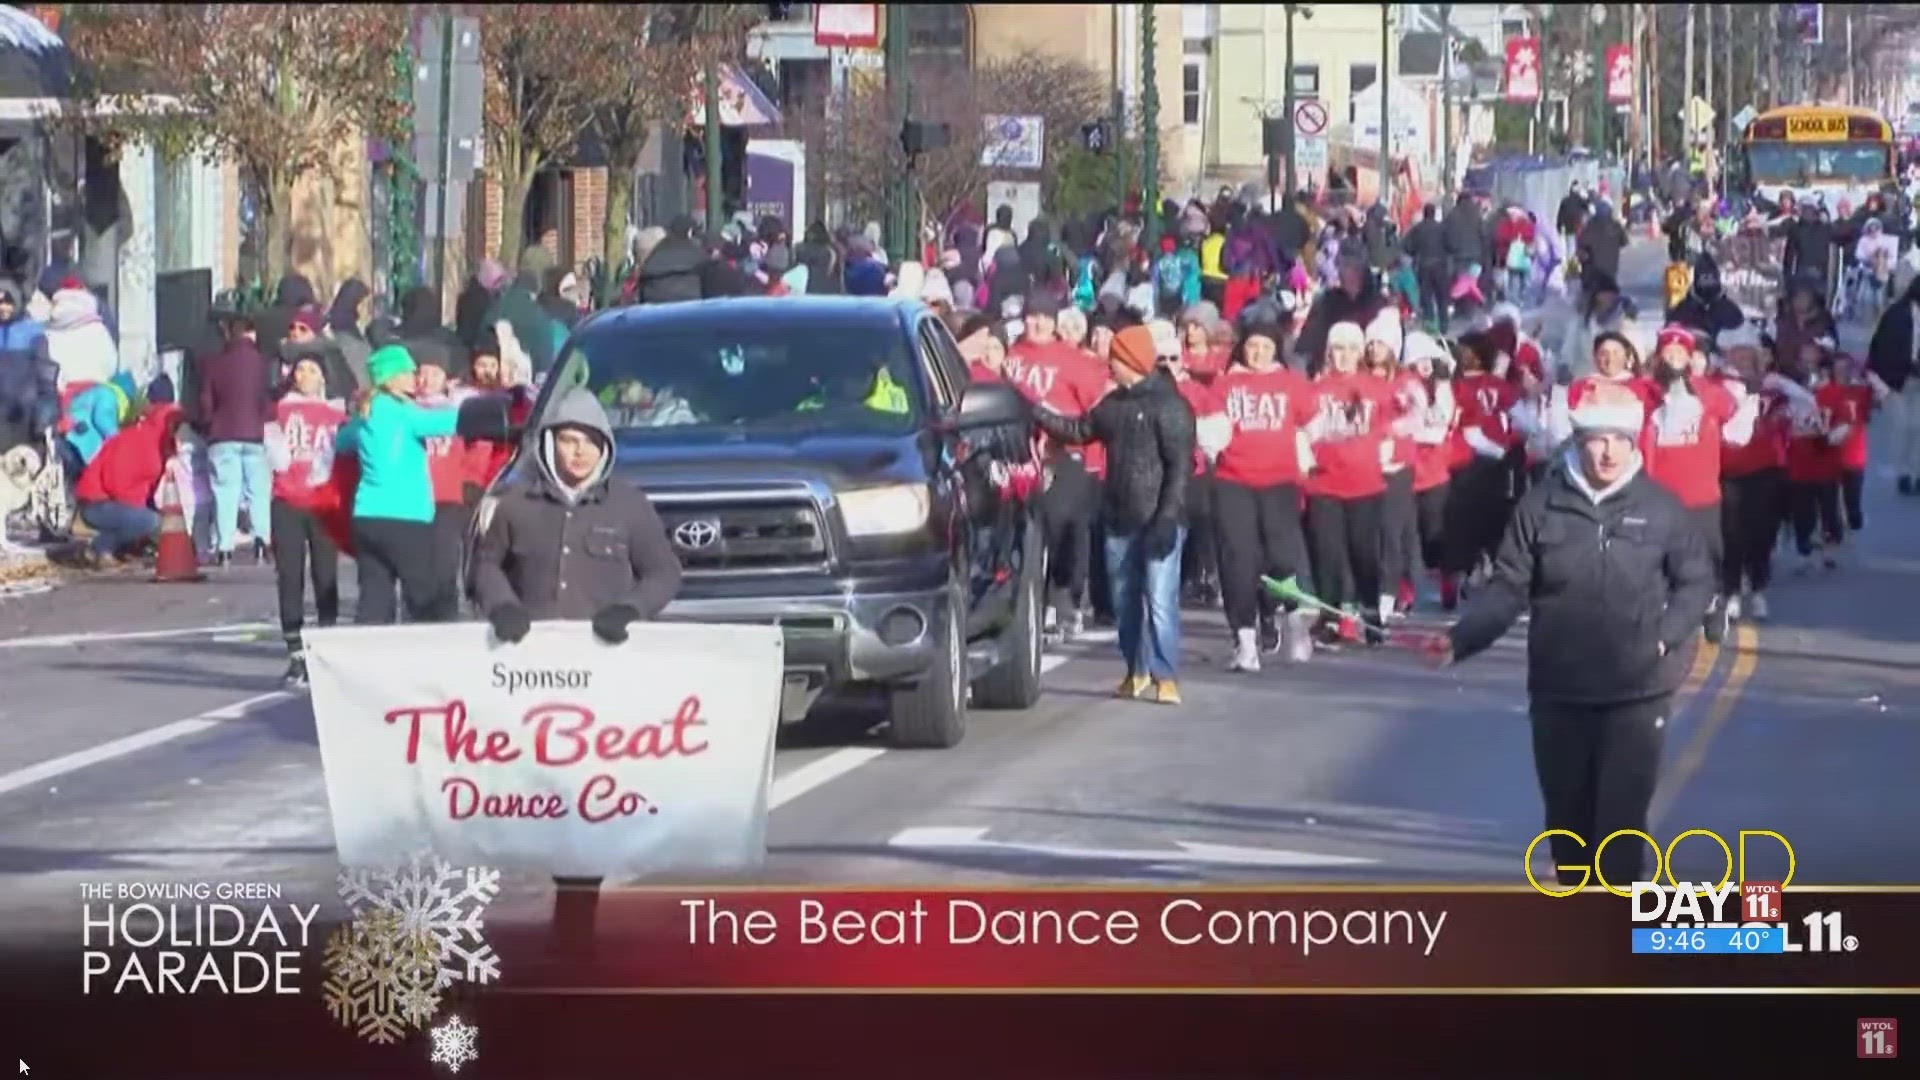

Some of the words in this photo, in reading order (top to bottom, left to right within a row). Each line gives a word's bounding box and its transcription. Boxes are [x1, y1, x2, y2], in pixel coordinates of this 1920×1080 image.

[1790, 116, 1825, 133] SCHOOL
[1827, 116, 1847, 132] BUS
[491, 662, 593, 695] Sponsor
[384, 699, 521, 765] The
[522, 692, 710, 767] Beat
[440, 776, 570, 821] Dance
[576, 773, 659, 825] Co.
